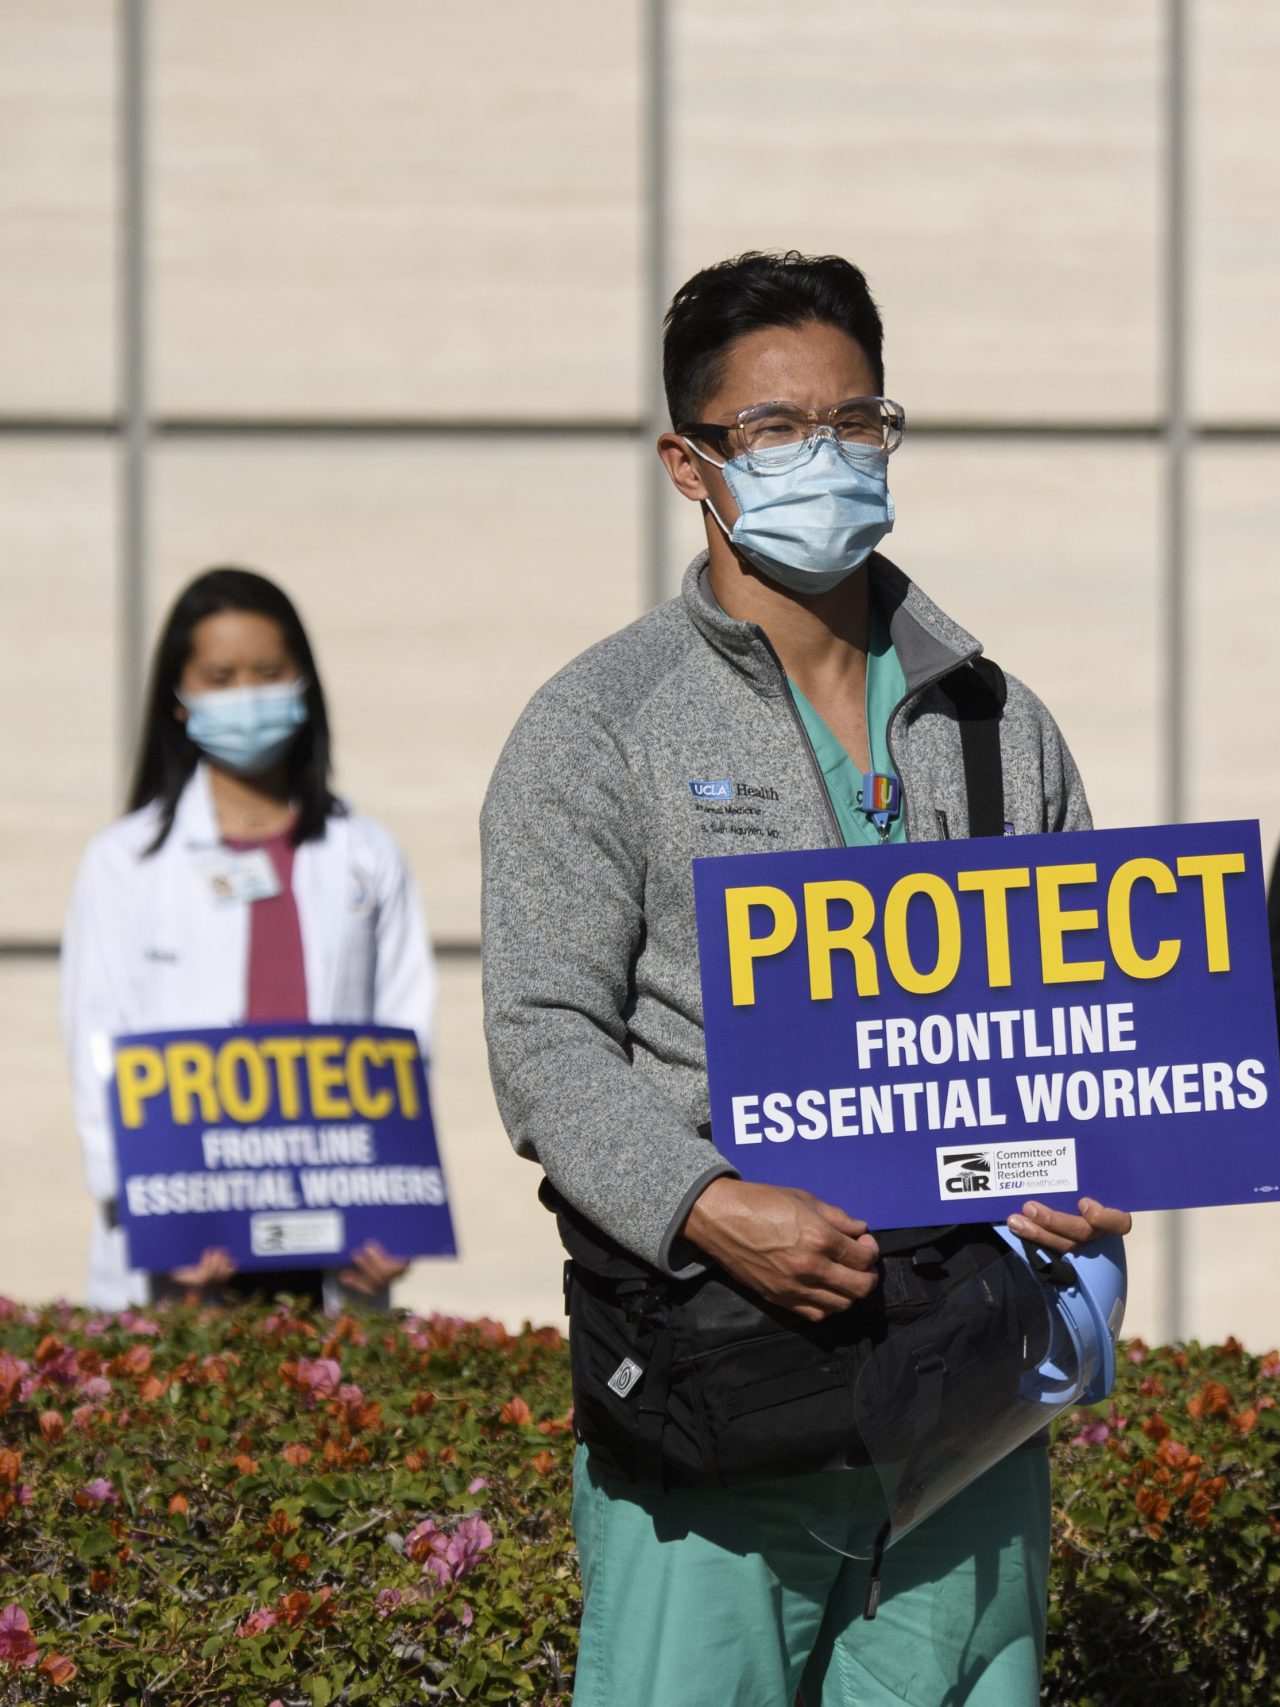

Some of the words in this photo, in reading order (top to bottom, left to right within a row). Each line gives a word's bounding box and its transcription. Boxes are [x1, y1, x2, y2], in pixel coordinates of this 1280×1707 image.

[694, 785, 727, 796] UCLA
[736, 783, 779, 800] Health
[725, 853, 1245, 1006] PROTECT
[856, 1003, 1137, 1069] FRONTLINE
[115, 1036, 420, 1129] PROTECT
[732, 1078, 1006, 1145] ESSENTIAL
[1016, 1059, 1267, 1122] WORKERS
[202, 1125, 374, 1168] FRONTLINE
[996, 1150, 1053, 1160] Committee
[1055, 1147, 1067, 1156] of
[997, 1160, 1034, 1170] Interns
[1036, 1158, 1057, 1168] and
[126, 1171, 296, 1216] ESSENTIAL
[300, 1166, 445, 1206] WORKERS
[997, 1169, 1049, 1180] Residents
